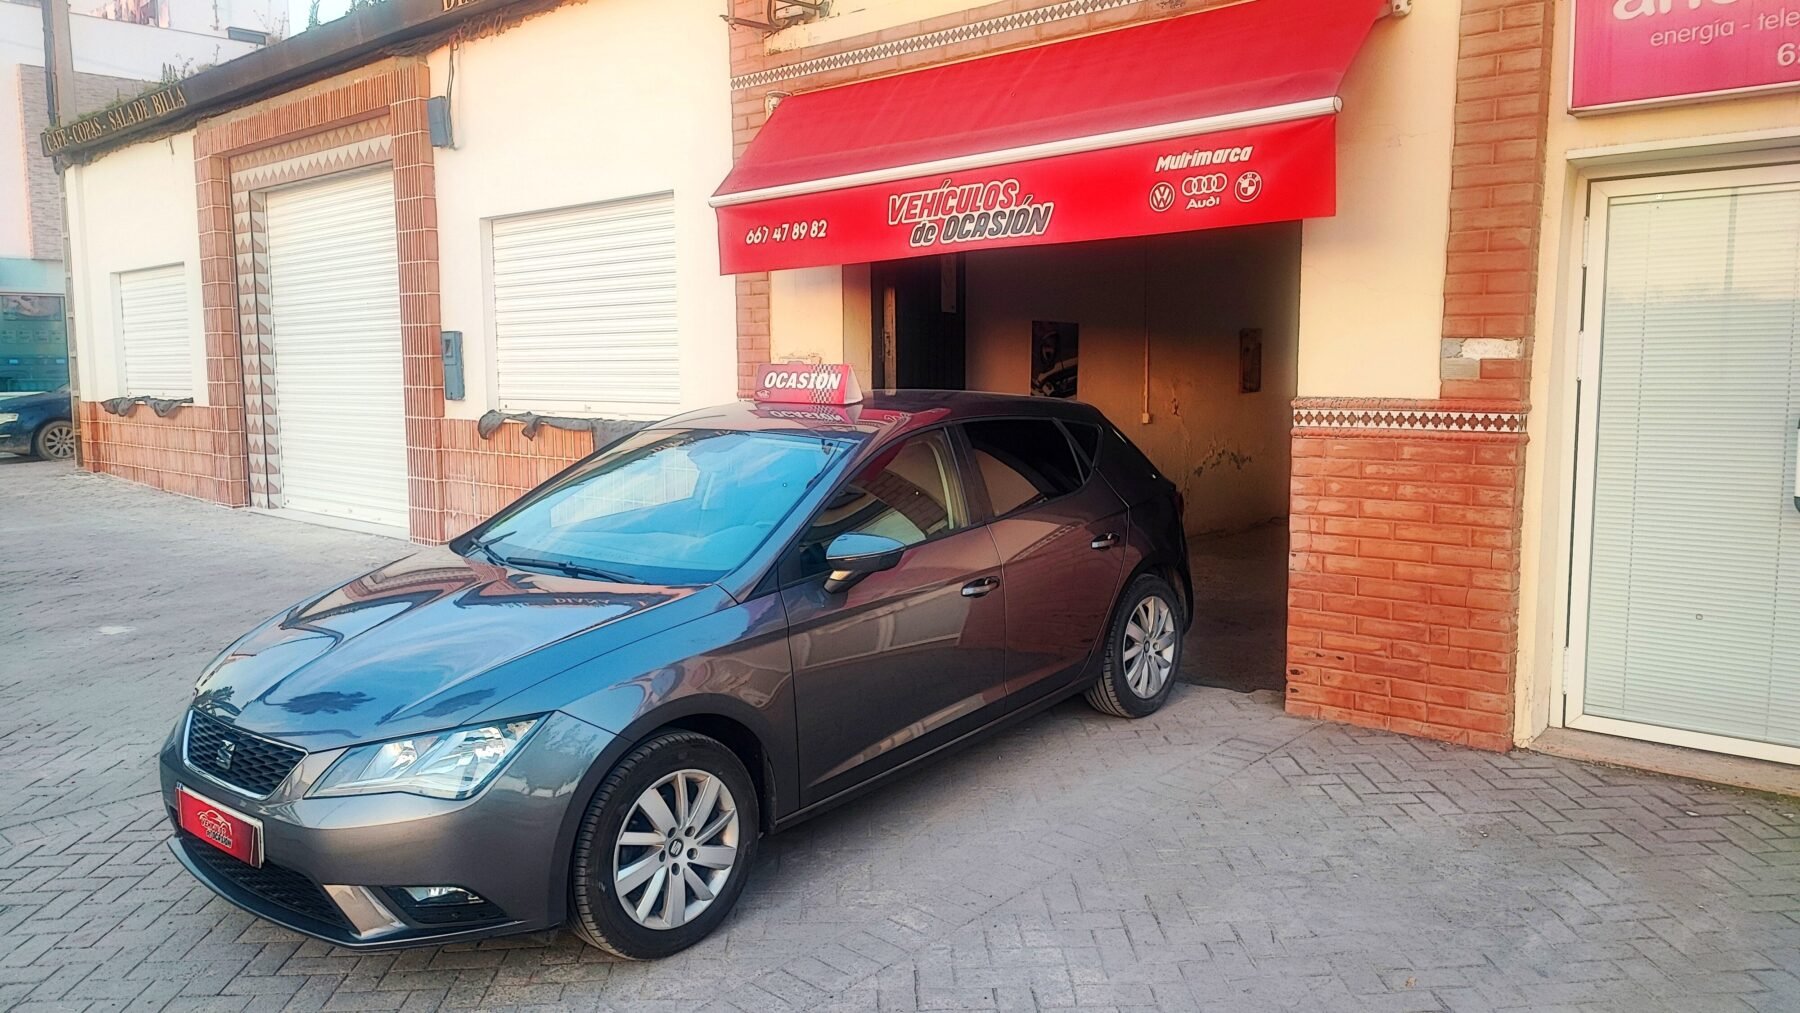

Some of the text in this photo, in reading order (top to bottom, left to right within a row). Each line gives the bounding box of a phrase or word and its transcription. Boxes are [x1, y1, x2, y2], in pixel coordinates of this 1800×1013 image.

[1650, 19, 1735, 47] energía
[1758, 7, 1800, 31] tele
[1777, 42, 1800, 66] 6
[72, 117, 102, 144] COPAS
[107, 104, 136, 131] SALA
[132, 98, 151, 121] DE
[888, 178, 1020, 225] VEHÍCULOS
[910, 195, 1054, 247] de OCASIÓN
[1185, 196, 1220, 210] Audi
[772, 223, 790, 242] 47
[791, 221, 808, 240] 89
[810, 219, 827, 238] 82
